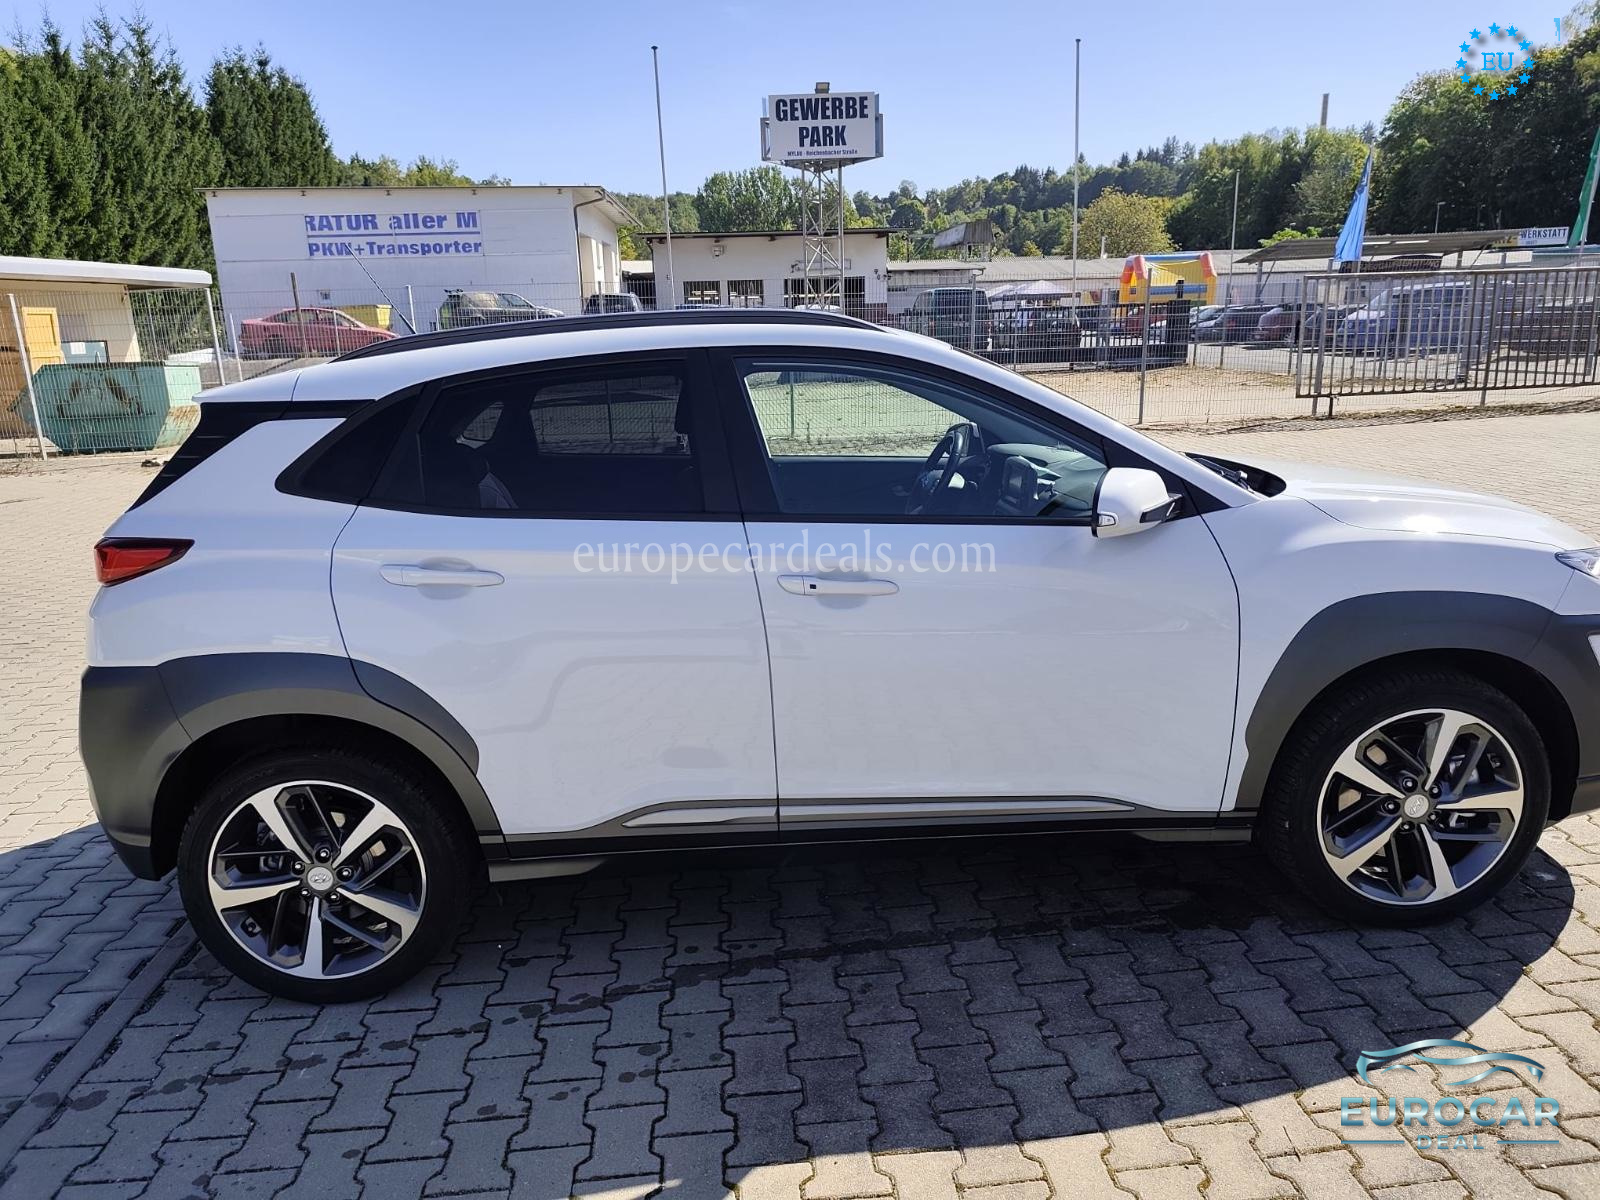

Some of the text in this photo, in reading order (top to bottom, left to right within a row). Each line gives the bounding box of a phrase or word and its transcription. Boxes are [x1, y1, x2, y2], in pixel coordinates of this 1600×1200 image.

[775, 96, 869, 122] GEWERBE
[798, 125, 847, 147] PARK
[388, 213, 448, 230] aller
[456, 211, 478, 228] M
[1520, 228, 1567, 239] WERKSTATT
[308, 240, 482, 257] PKW+Transporter
